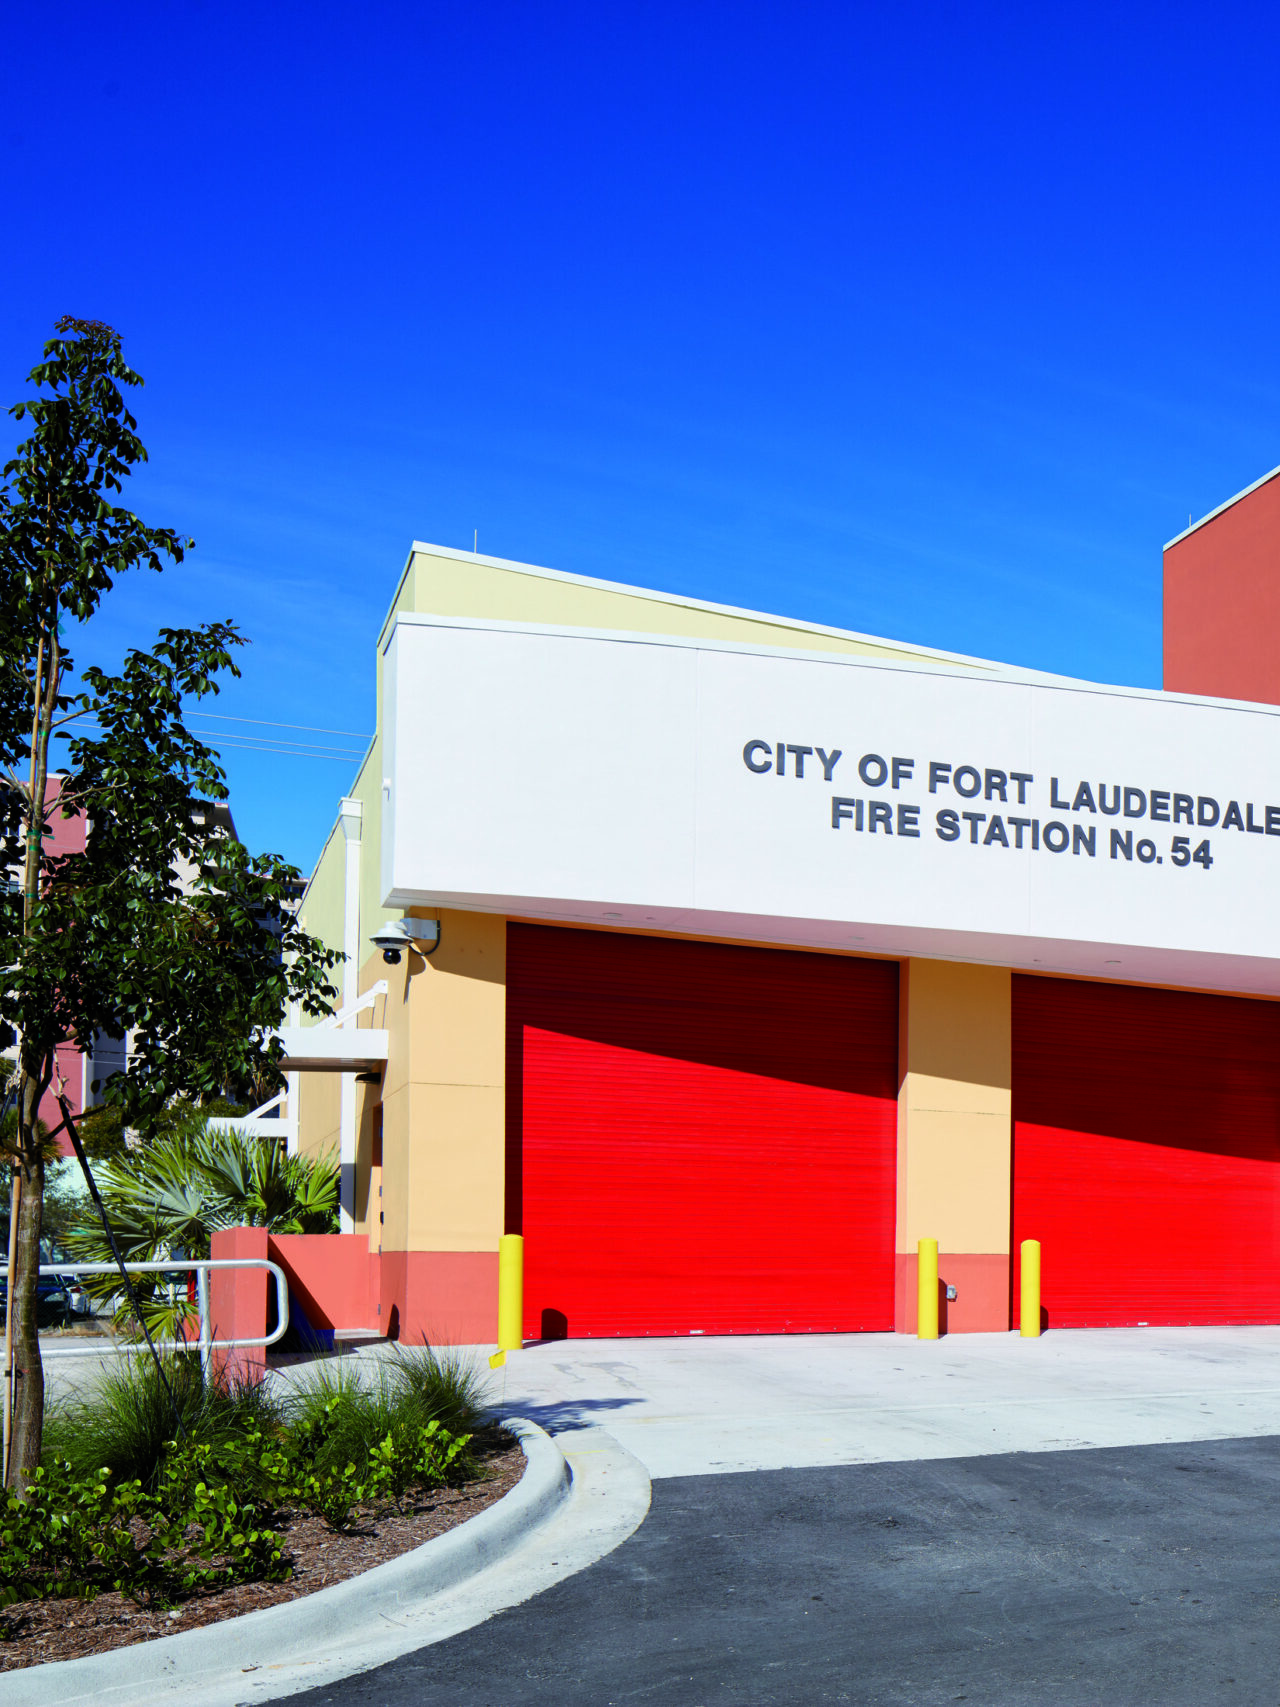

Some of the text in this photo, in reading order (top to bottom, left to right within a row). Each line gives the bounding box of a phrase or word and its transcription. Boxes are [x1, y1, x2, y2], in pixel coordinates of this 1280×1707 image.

[742, 739, 843, 781] CITY
[858, 753, 915, 789] OF
[928, 761, 1034, 804] FORT
[831, 796, 1214, 870] FIRE STATION No. 54
